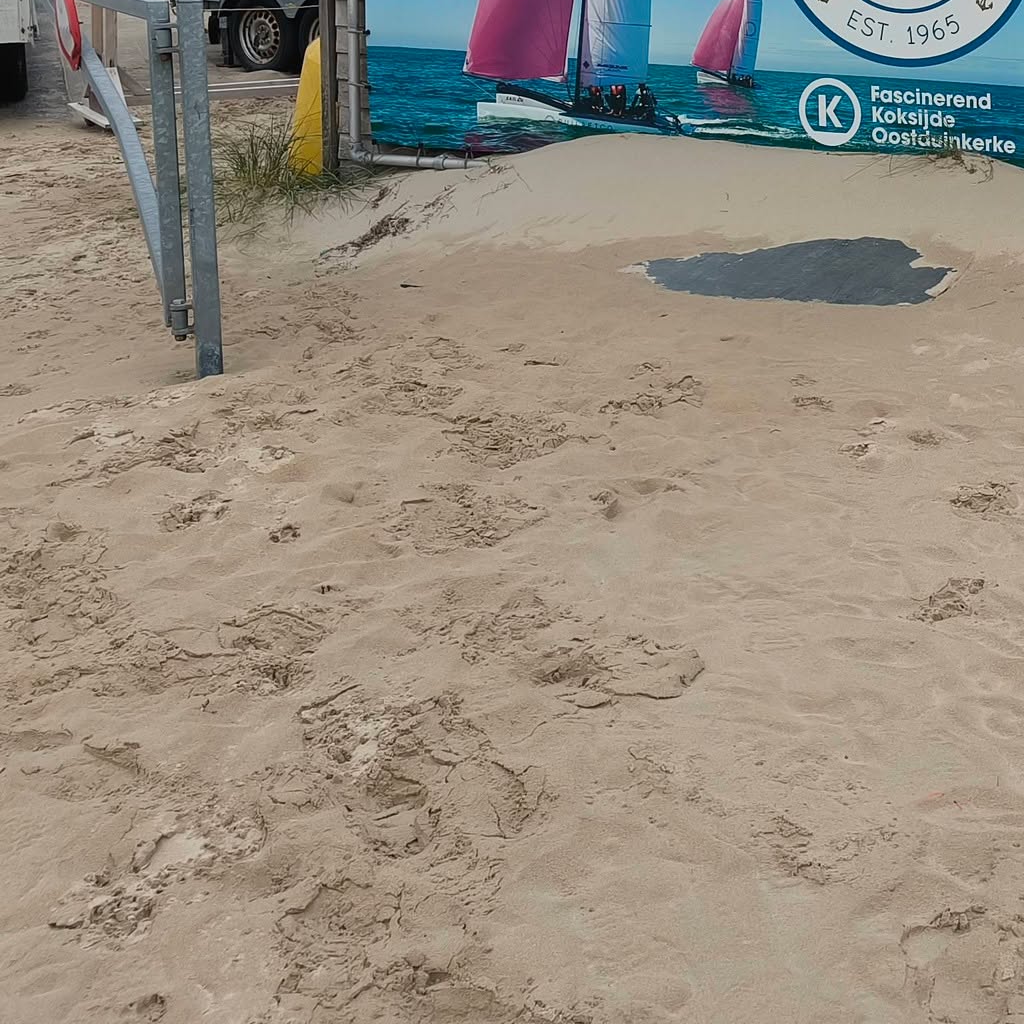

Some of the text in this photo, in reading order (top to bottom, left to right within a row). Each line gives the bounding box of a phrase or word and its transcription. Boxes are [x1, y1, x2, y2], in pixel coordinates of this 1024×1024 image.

[846, 9, 960, 46] EST. 1965
[870, 85, 992, 110] Fascinerend
[872, 106, 956, 130] Koksijde
